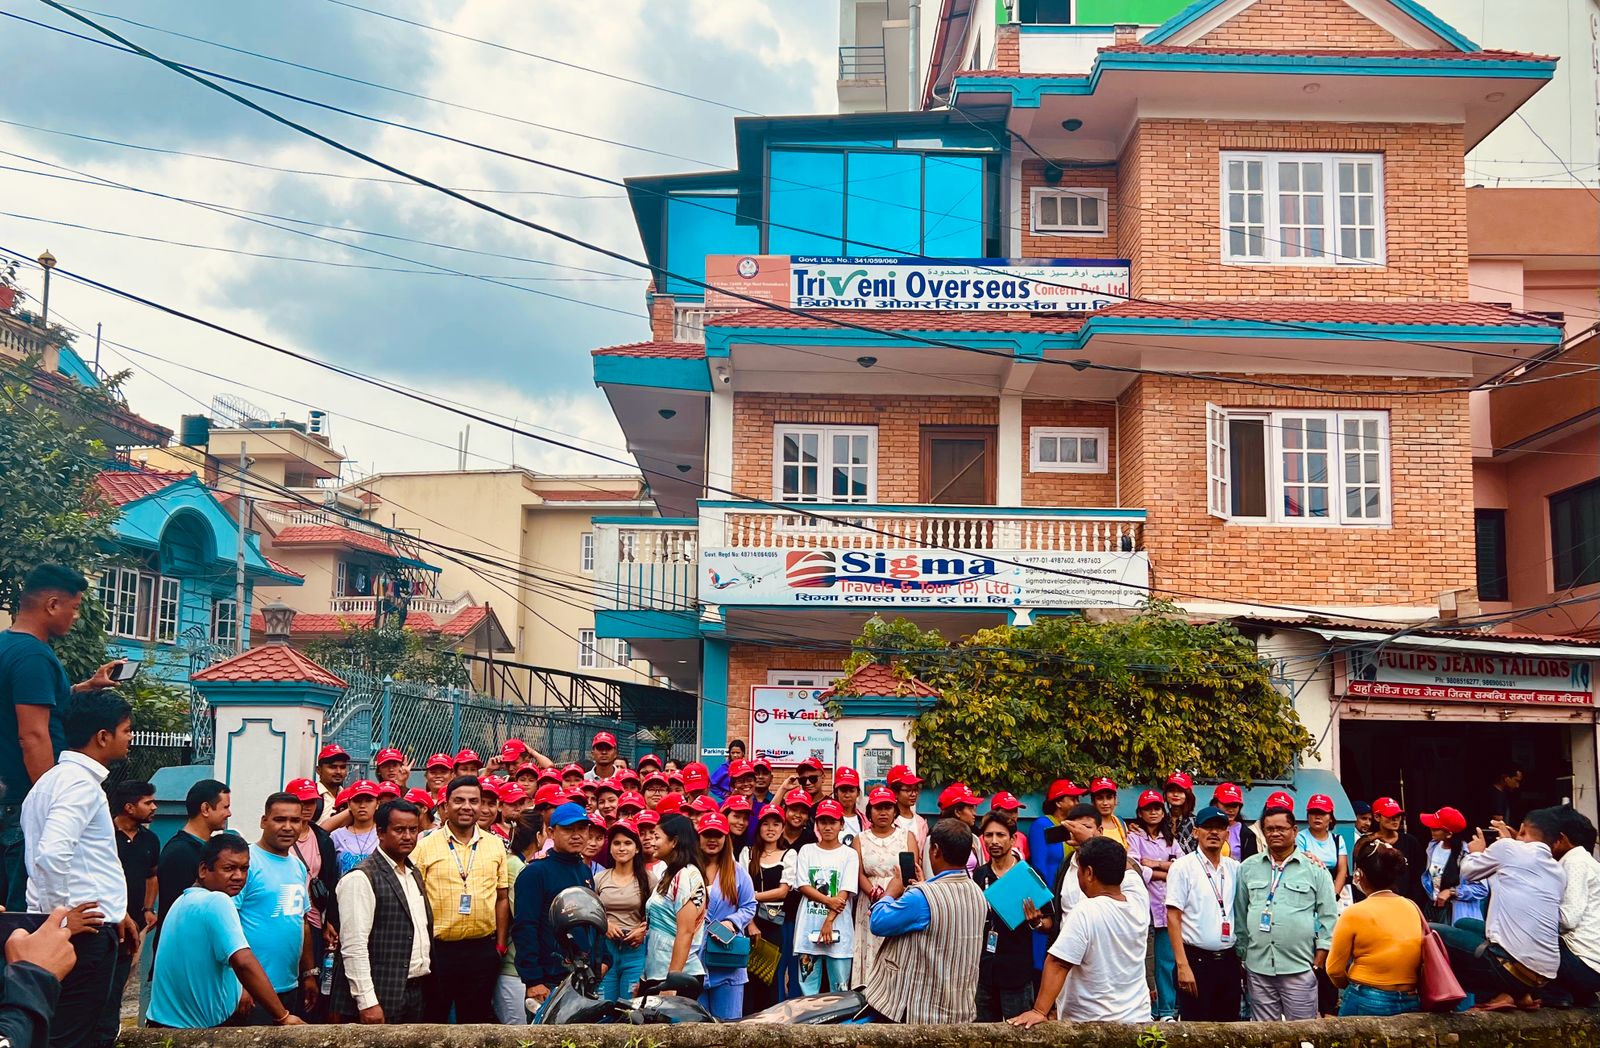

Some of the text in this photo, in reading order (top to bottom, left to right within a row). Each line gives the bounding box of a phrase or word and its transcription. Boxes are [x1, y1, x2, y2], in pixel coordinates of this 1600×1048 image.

[905, 271, 1030, 299] Overseas
[1034, 283, 1077, 296] Concern
[1107, 282, 1128, 296] Ltd.
[842, 551, 997, 579] Sigma
[838, 579, 894, 594] Travels
[900, 580, 913, 594] &
[918, 580, 951, 594] Tour
[985, 581, 1012, 595] Ltd.
[1442, 655, 1495, 675] JEANS
[1500, 658, 1570, 678] TAILORS
[1354, 683, 1372, 695] यहाँ
[1374, 683, 1400, 695] लेडिज
[1402, 687, 1421, 696] एण्ड
[1423, 686, 1446, 697] जेन्स
[1447, 687, 1472, 699] जिन्स
[703, 748, 725, 756] Parking
[766, 748, 794, 756] Sigma
